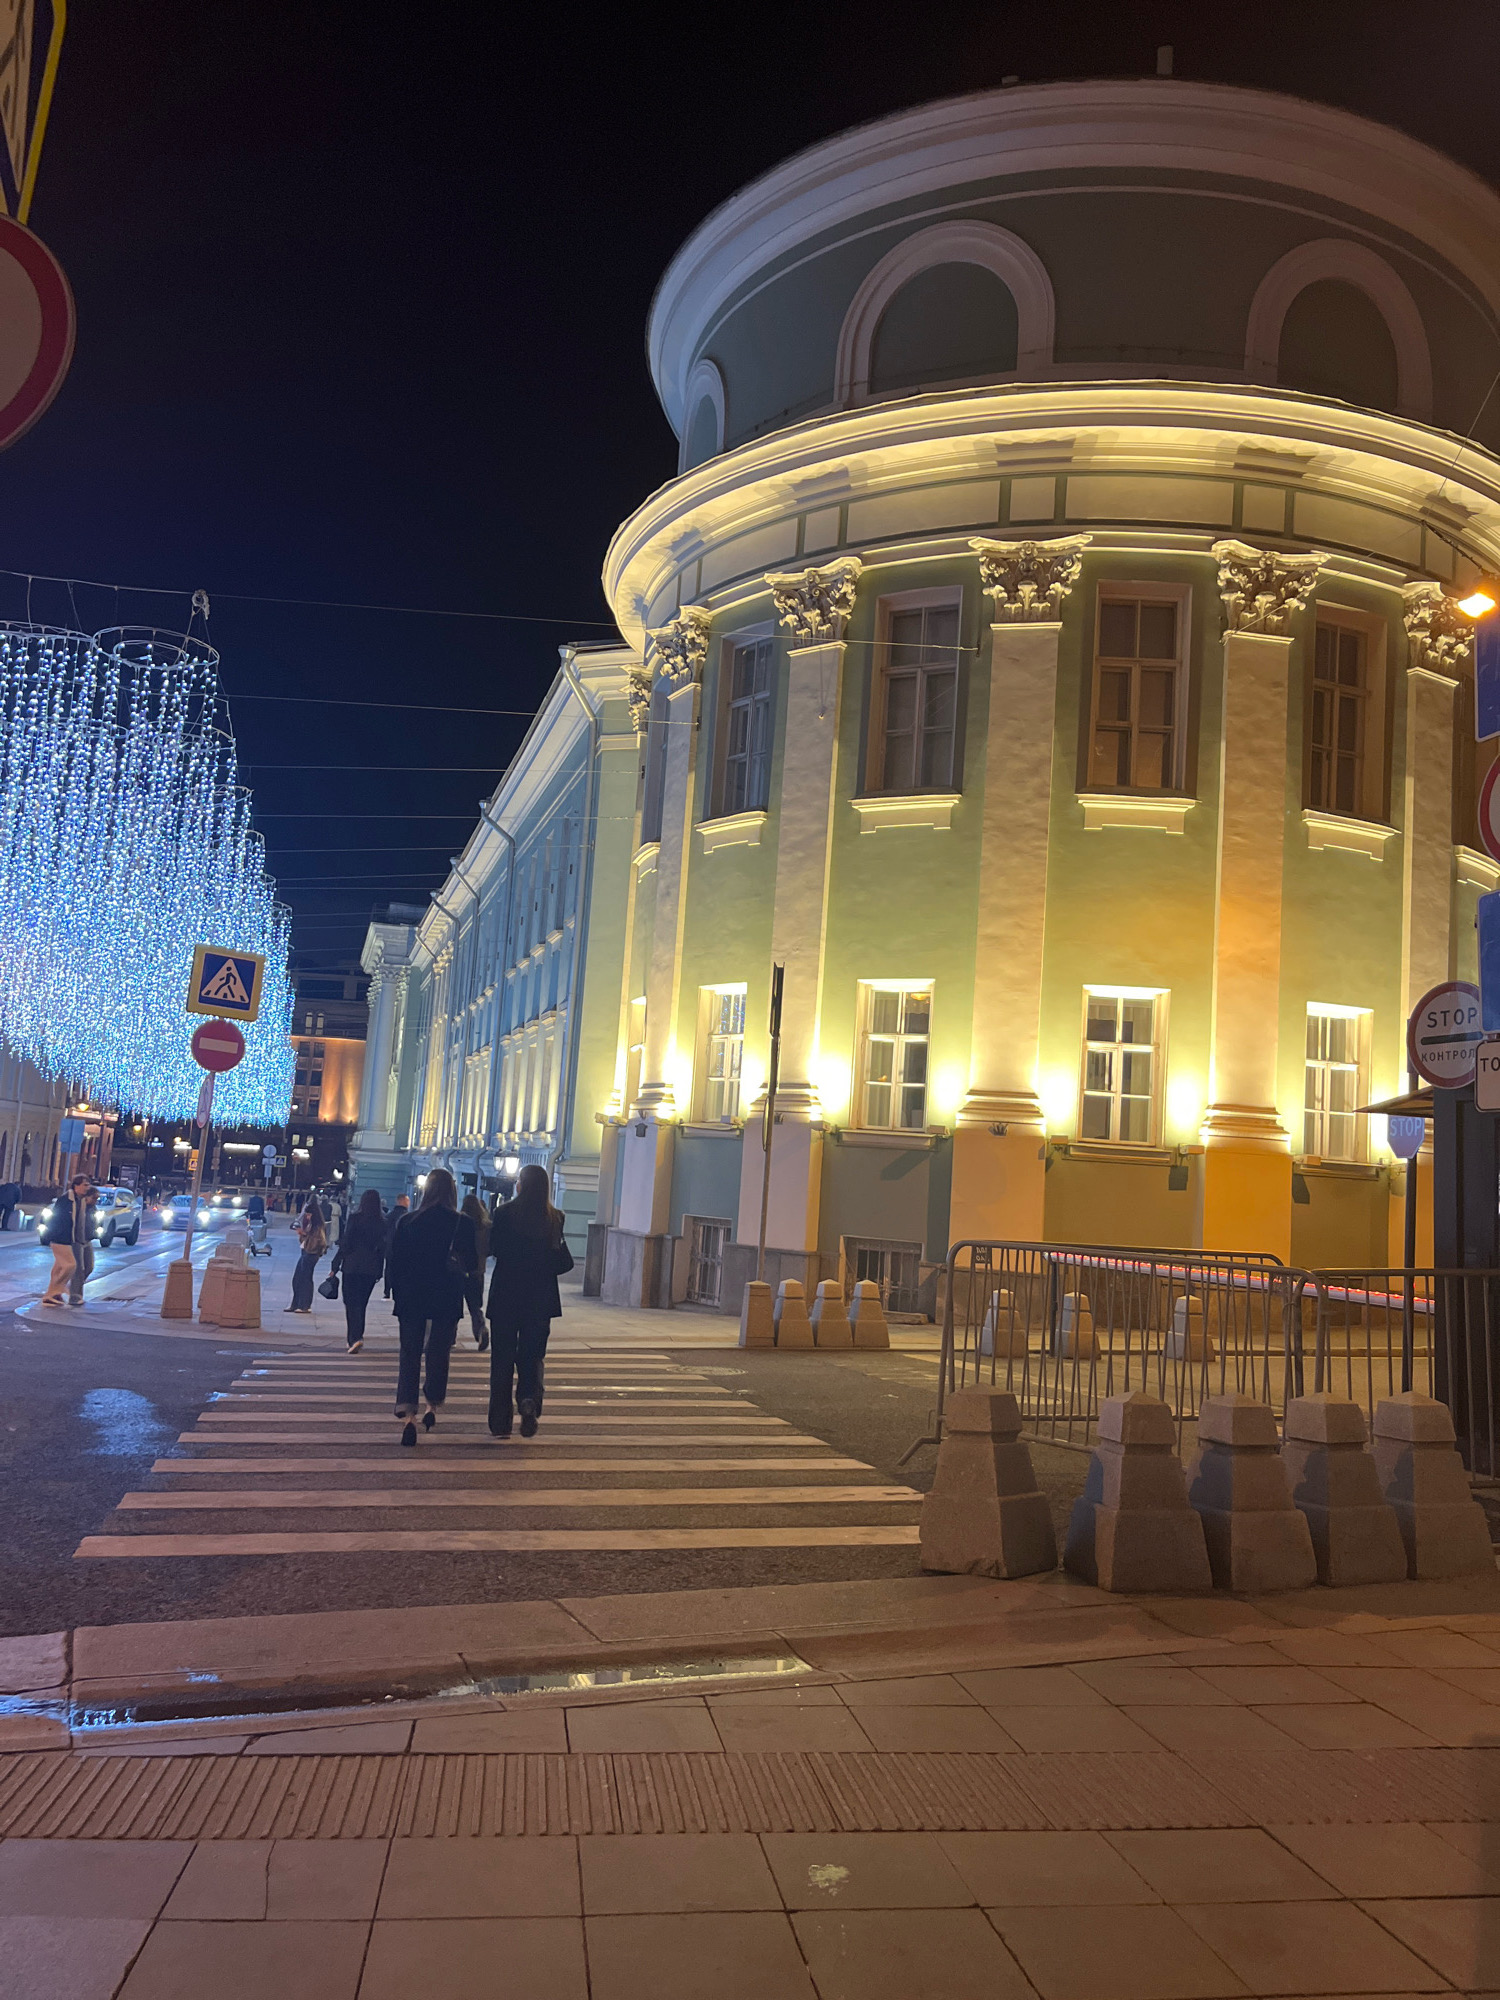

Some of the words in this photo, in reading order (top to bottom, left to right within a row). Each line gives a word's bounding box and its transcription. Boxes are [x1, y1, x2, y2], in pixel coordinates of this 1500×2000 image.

[1427, 1006, 1477, 1028] STOP
[1421, 1048, 1475, 1062] КОНТРОЛ
[1480, 1057, 1500, 1073] ТО
[1389, 1117, 1422, 1137] STOP
